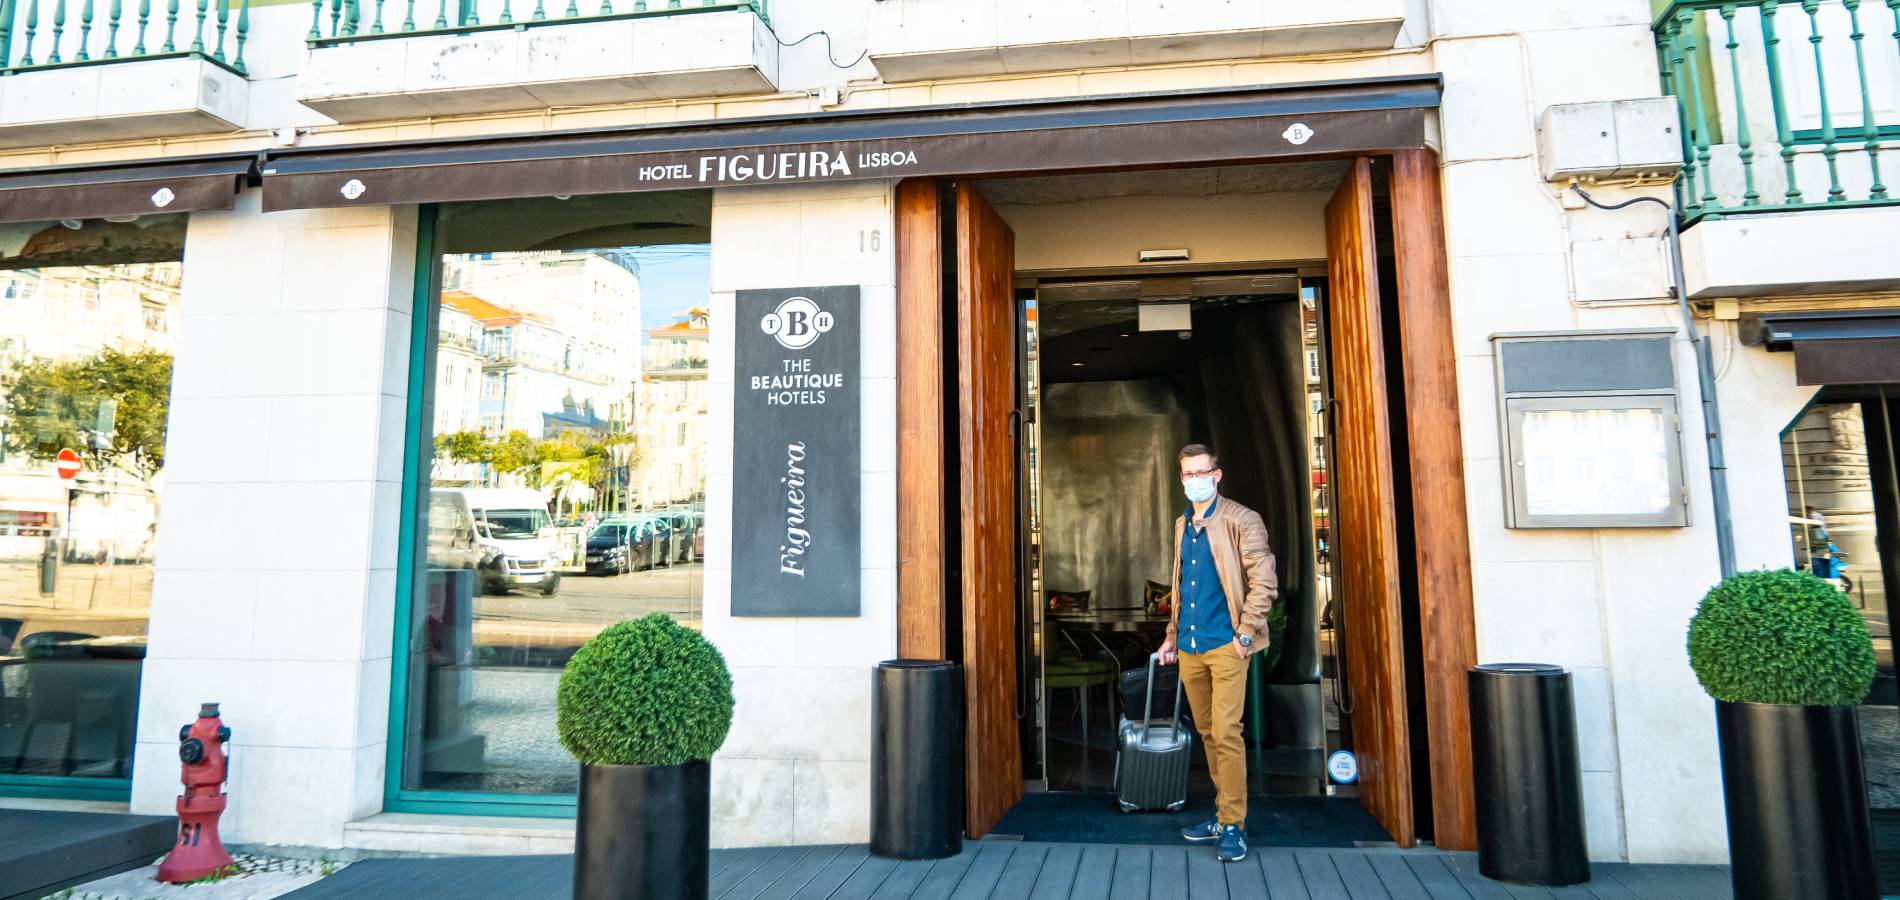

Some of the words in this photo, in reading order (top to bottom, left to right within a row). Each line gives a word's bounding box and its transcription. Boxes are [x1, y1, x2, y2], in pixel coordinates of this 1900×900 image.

[639, 165, 692, 181] HOTEL
[699, 150, 851, 182] FIGUEIRA
[858, 151, 918, 169] LISBOA
[859, 229, 880, 253] 16
[782, 359, 811, 372] THE
[751, 374, 843, 389] BEAUTIQUE
[767, 391, 826, 405] HOTELS
[780, 441, 811, 578] Figueira
